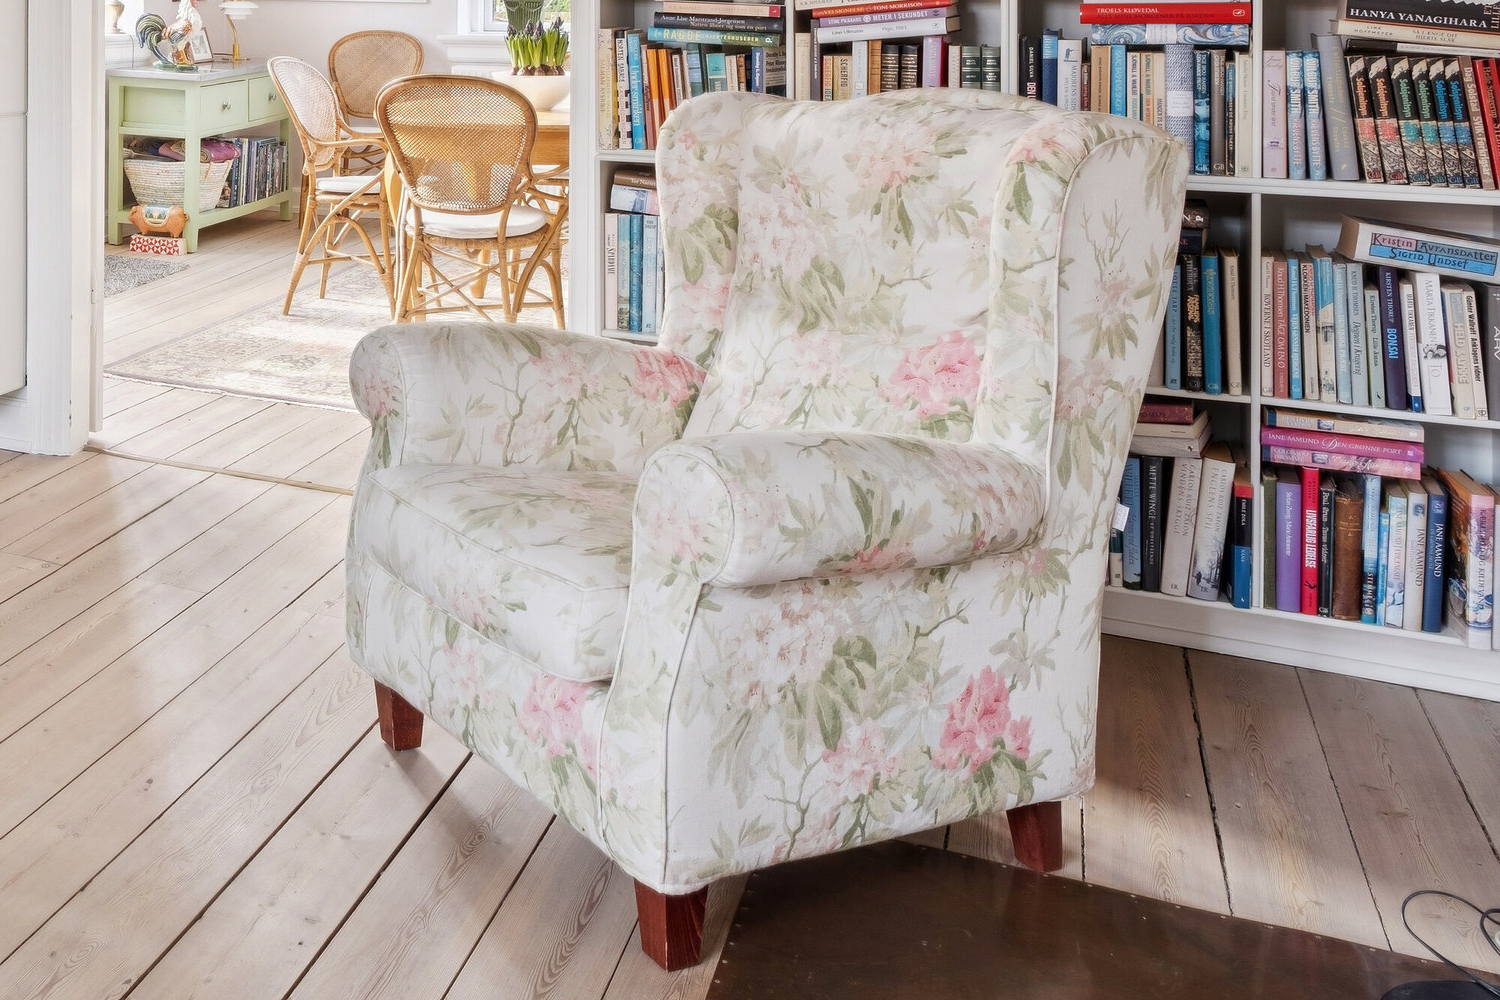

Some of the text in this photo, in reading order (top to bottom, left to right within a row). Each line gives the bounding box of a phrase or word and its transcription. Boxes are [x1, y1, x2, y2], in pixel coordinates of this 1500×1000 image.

[1350, 8, 1488, 29] HANYA YANAGIHARA
[1387, 327, 1399, 359] BONSAI
